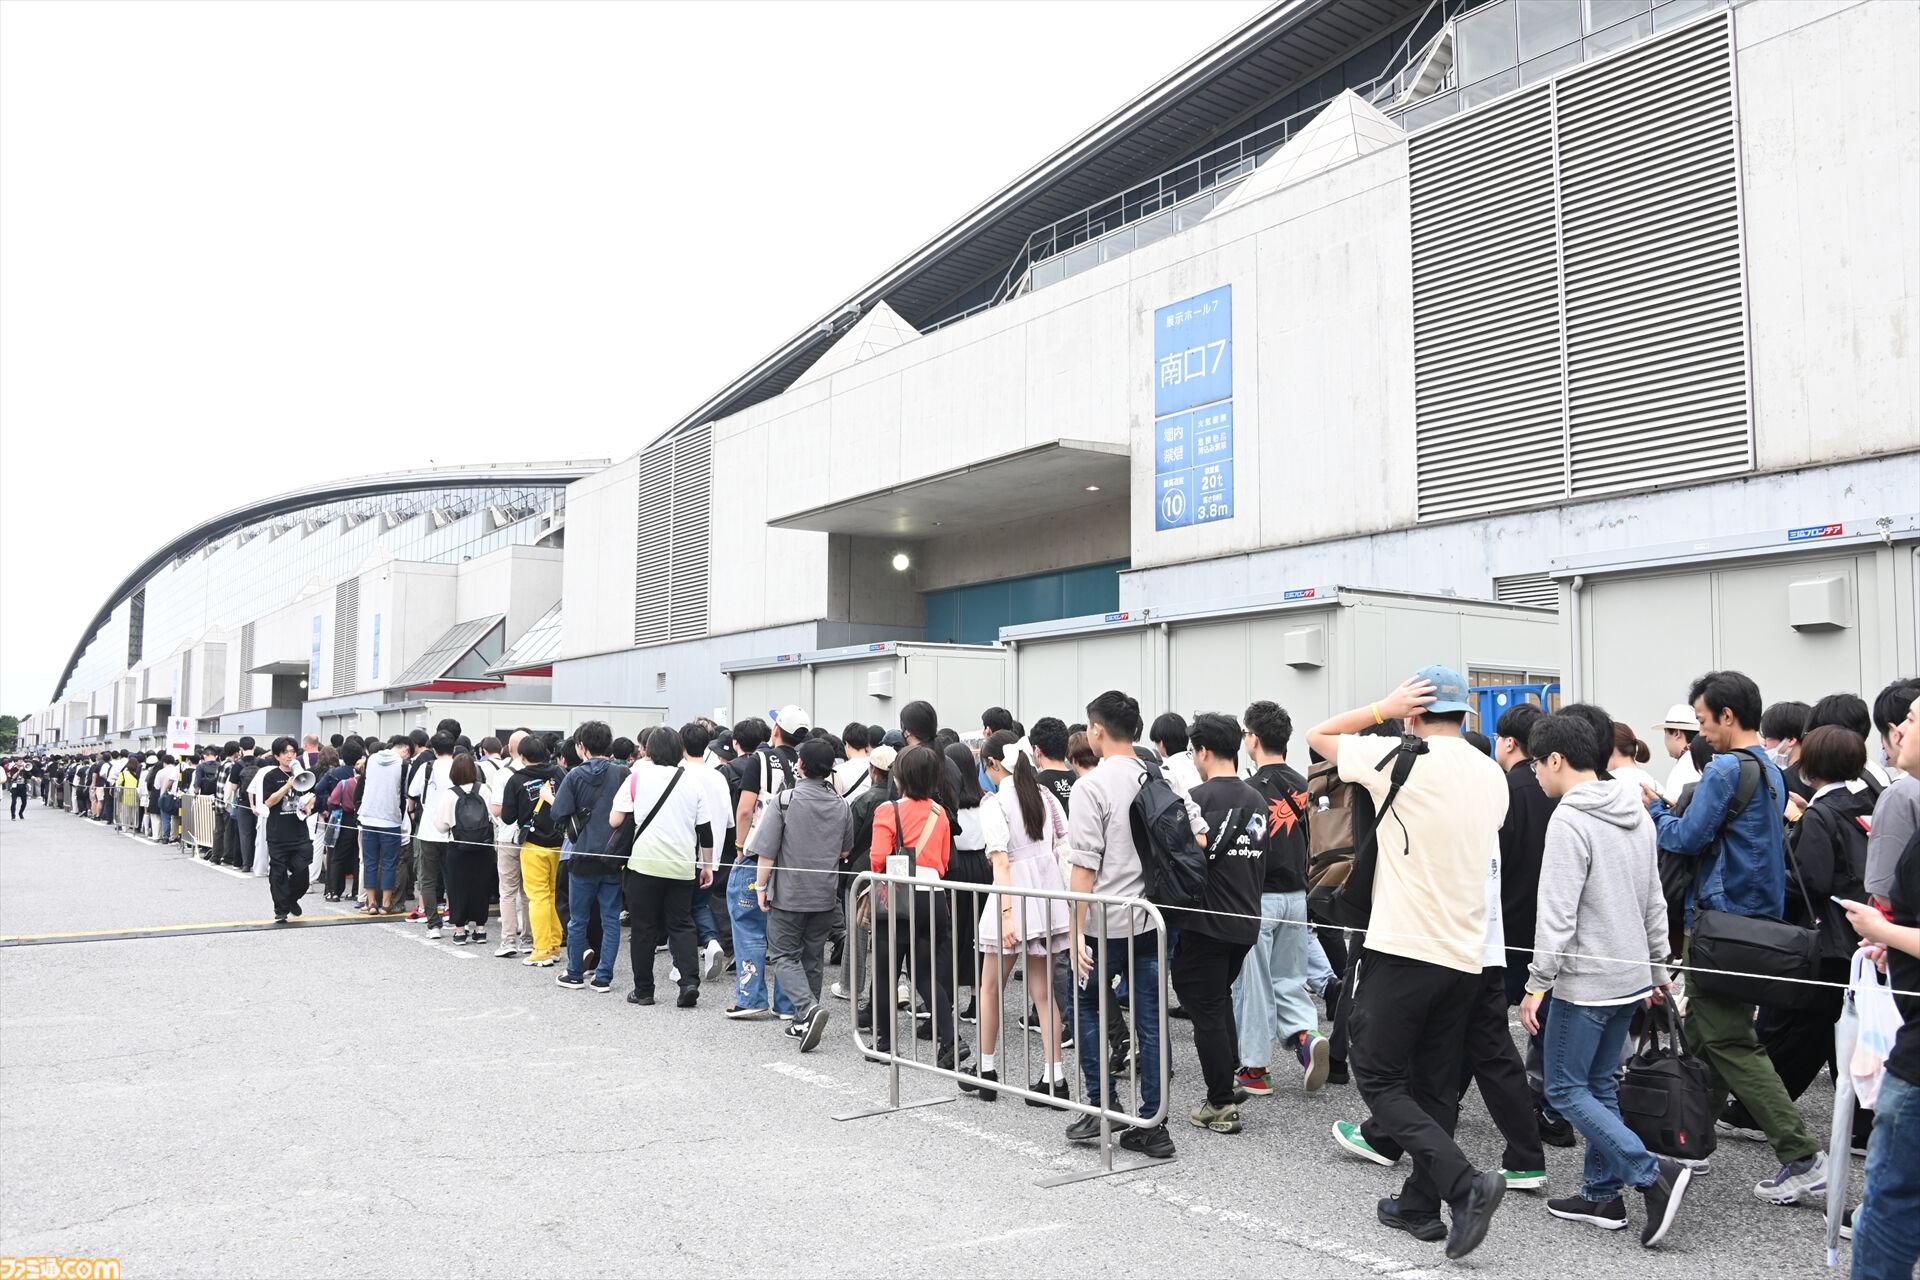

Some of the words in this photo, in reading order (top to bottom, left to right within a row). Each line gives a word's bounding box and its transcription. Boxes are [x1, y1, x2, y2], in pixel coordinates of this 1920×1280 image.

[1166, 299, 1219, 329] 展示ホール7
[1160, 338, 1226, 388] 南口7
[1201, 473, 1223, 490] 20t
[1164, 494, 1183, 517] 10
[1197, 503, 1228, 519] 3.8m
